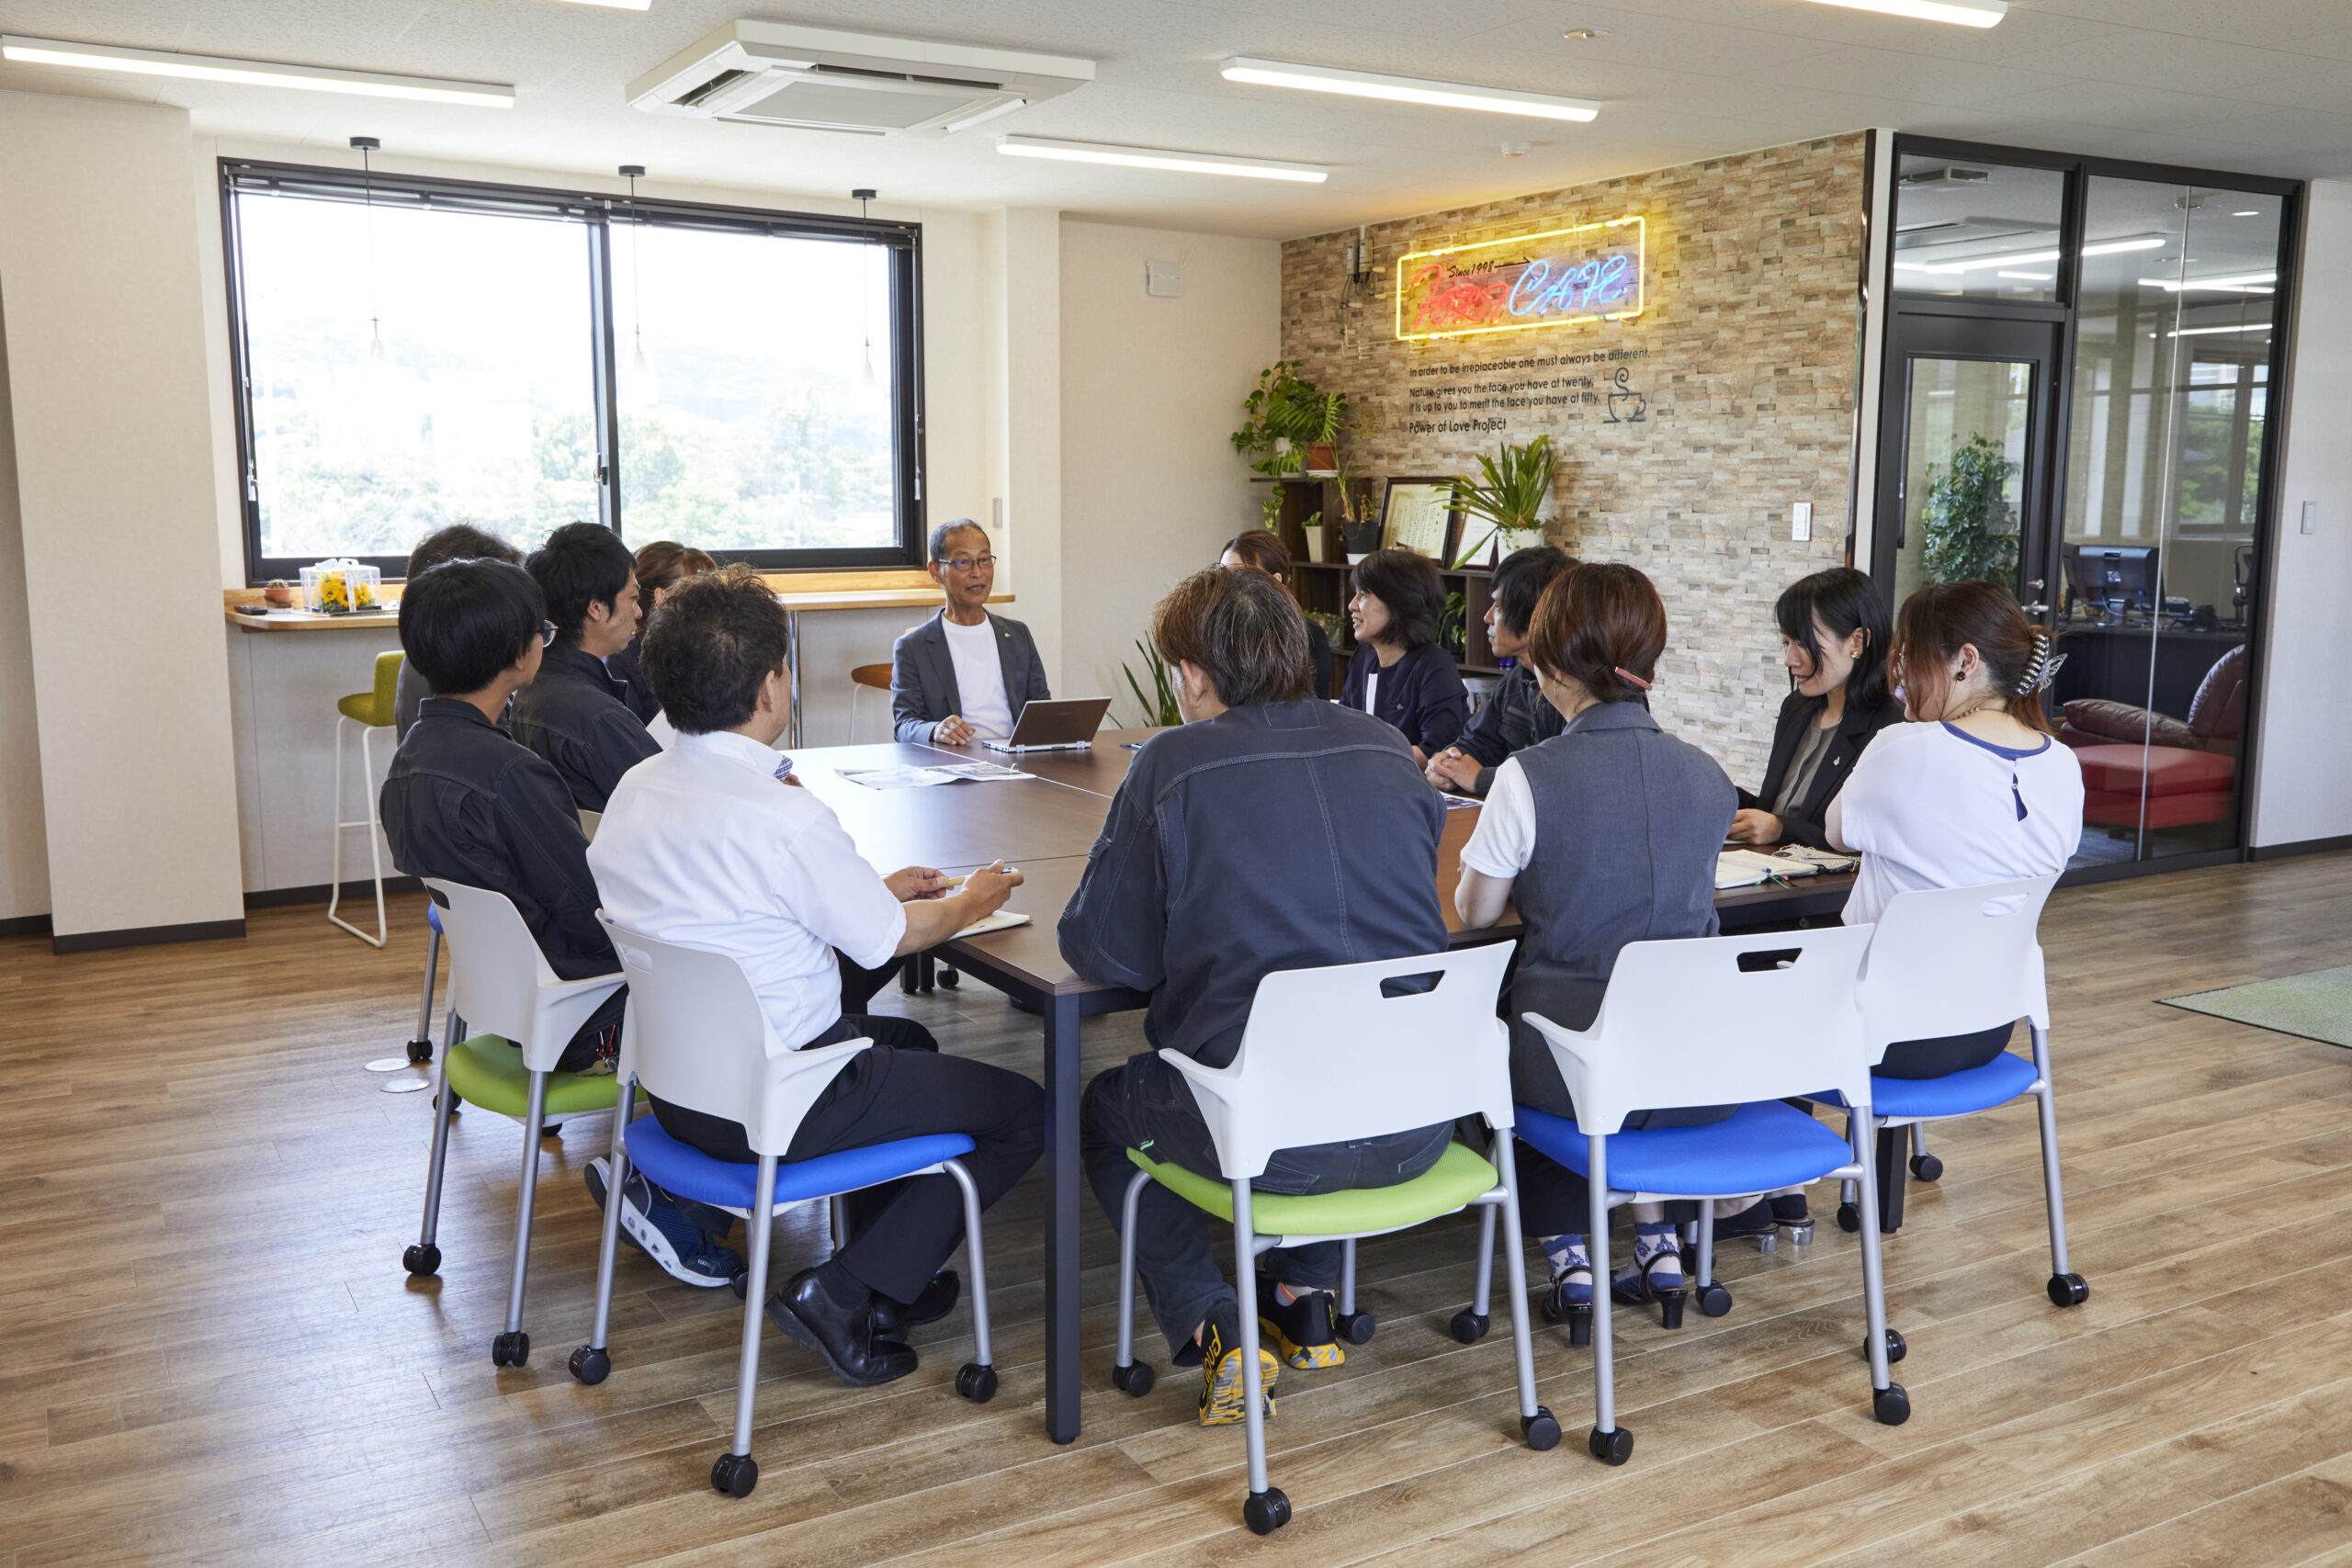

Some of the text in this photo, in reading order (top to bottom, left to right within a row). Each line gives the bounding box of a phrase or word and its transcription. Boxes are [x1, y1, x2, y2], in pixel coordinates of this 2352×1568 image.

[1410, 254, 1628, 329] FORT CAFE
[1409, 347, 1651, 377] In order to be irreplaceable one must always be different.
[1409, 387, 1434, 398] Nature
[1436, 385, 1456, 398] gives
[1457, 386, 1472, 396] you
[1474, 383, 1487, 394] the
[1488, 382, 1508, 393] face
[1510, 382, 1525, 394] you
[1527, 379, 1549, 389] have
[1551, 378, 1560, 389] at
[1415, 402, 1421, 412] is
[1422, 403, 1432, 414] up
[1434, 401, 1442, 412] to
[1443, 402, 1458, 413] you
[1459, 400, 1467, 410] to
[1469, 398, 1490, 410] merit
[1491, 398, 1505, 408] the
[1506, 397, 1526, 408] face
[1528, 396, 1544, 408] you
[1545, 394, 1568, 405] have
[1570, 393, 1579, 404] at
[1581, 391, 1600, 405] fifty.
[1408, 418, 1507, 434] Power of Love Project
